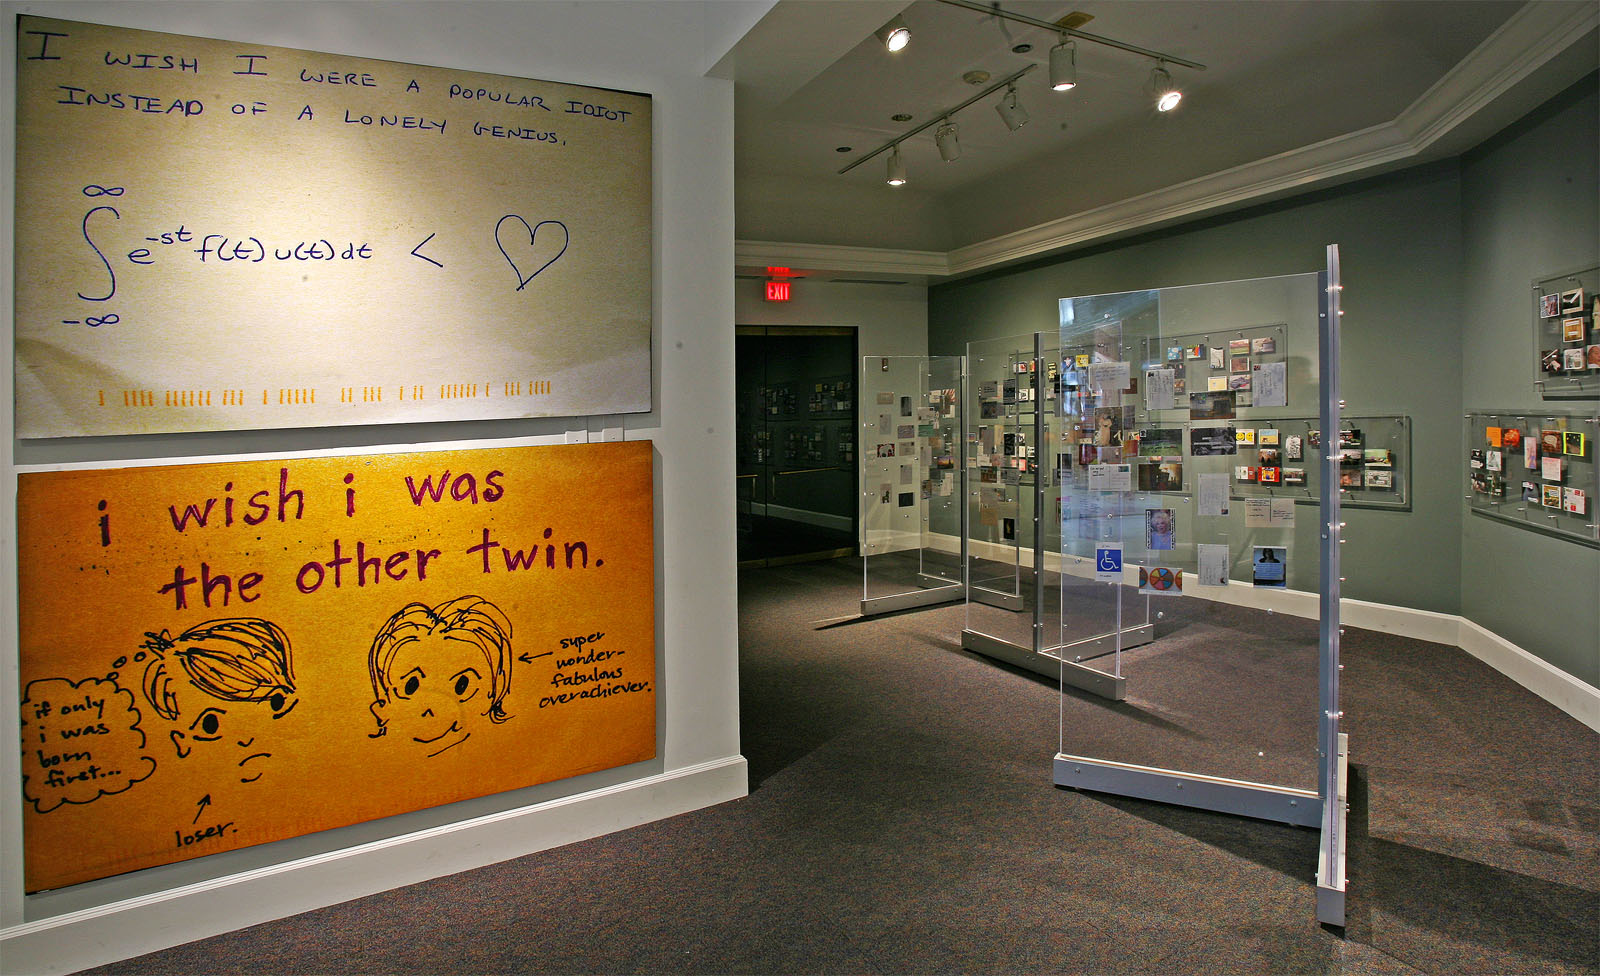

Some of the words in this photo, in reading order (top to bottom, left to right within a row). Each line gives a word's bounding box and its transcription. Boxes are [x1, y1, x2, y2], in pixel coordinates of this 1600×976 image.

[24, 30, 69, 61] I
[103, 51, 198, 73] WISH
[232, 54, 268, 76] I
[300, 68, 377, 87] WERE
[406, 79, 420, 93] A
[449, 80, 553, 112] POPULAR
[564, 100, 633, 123] IDIOT
[55, 83, 204, 117] INSTEAD
[231, 101, 267, 116] OF
[297, 104, 313, 121] A
[344, 109, 447, 135] LONELY
[767, 282, 791, 301] EXIT
[97, 499, 111, 548] i
[168, 467, 304, 533] wish
[343, 472, 356, 518] i
[404, 469, 505, 507] was
[156, 561, 264, 611] the
[295, 539, 441, 595] other
[466, 527, 605, 574] twin.
[559, 631, 606, 655] super
[550, 665, 625, 690] fabulous
[33, 700, 52, 720] if
[60, 695, 105, 720] only
[538, 679, 652, 709] overachiever.
[39, 725, 46, 744] i
[60, 723, 110, 740] was
[36, 750, 92, 769] born
[175, 819, 238, 848] loser.
